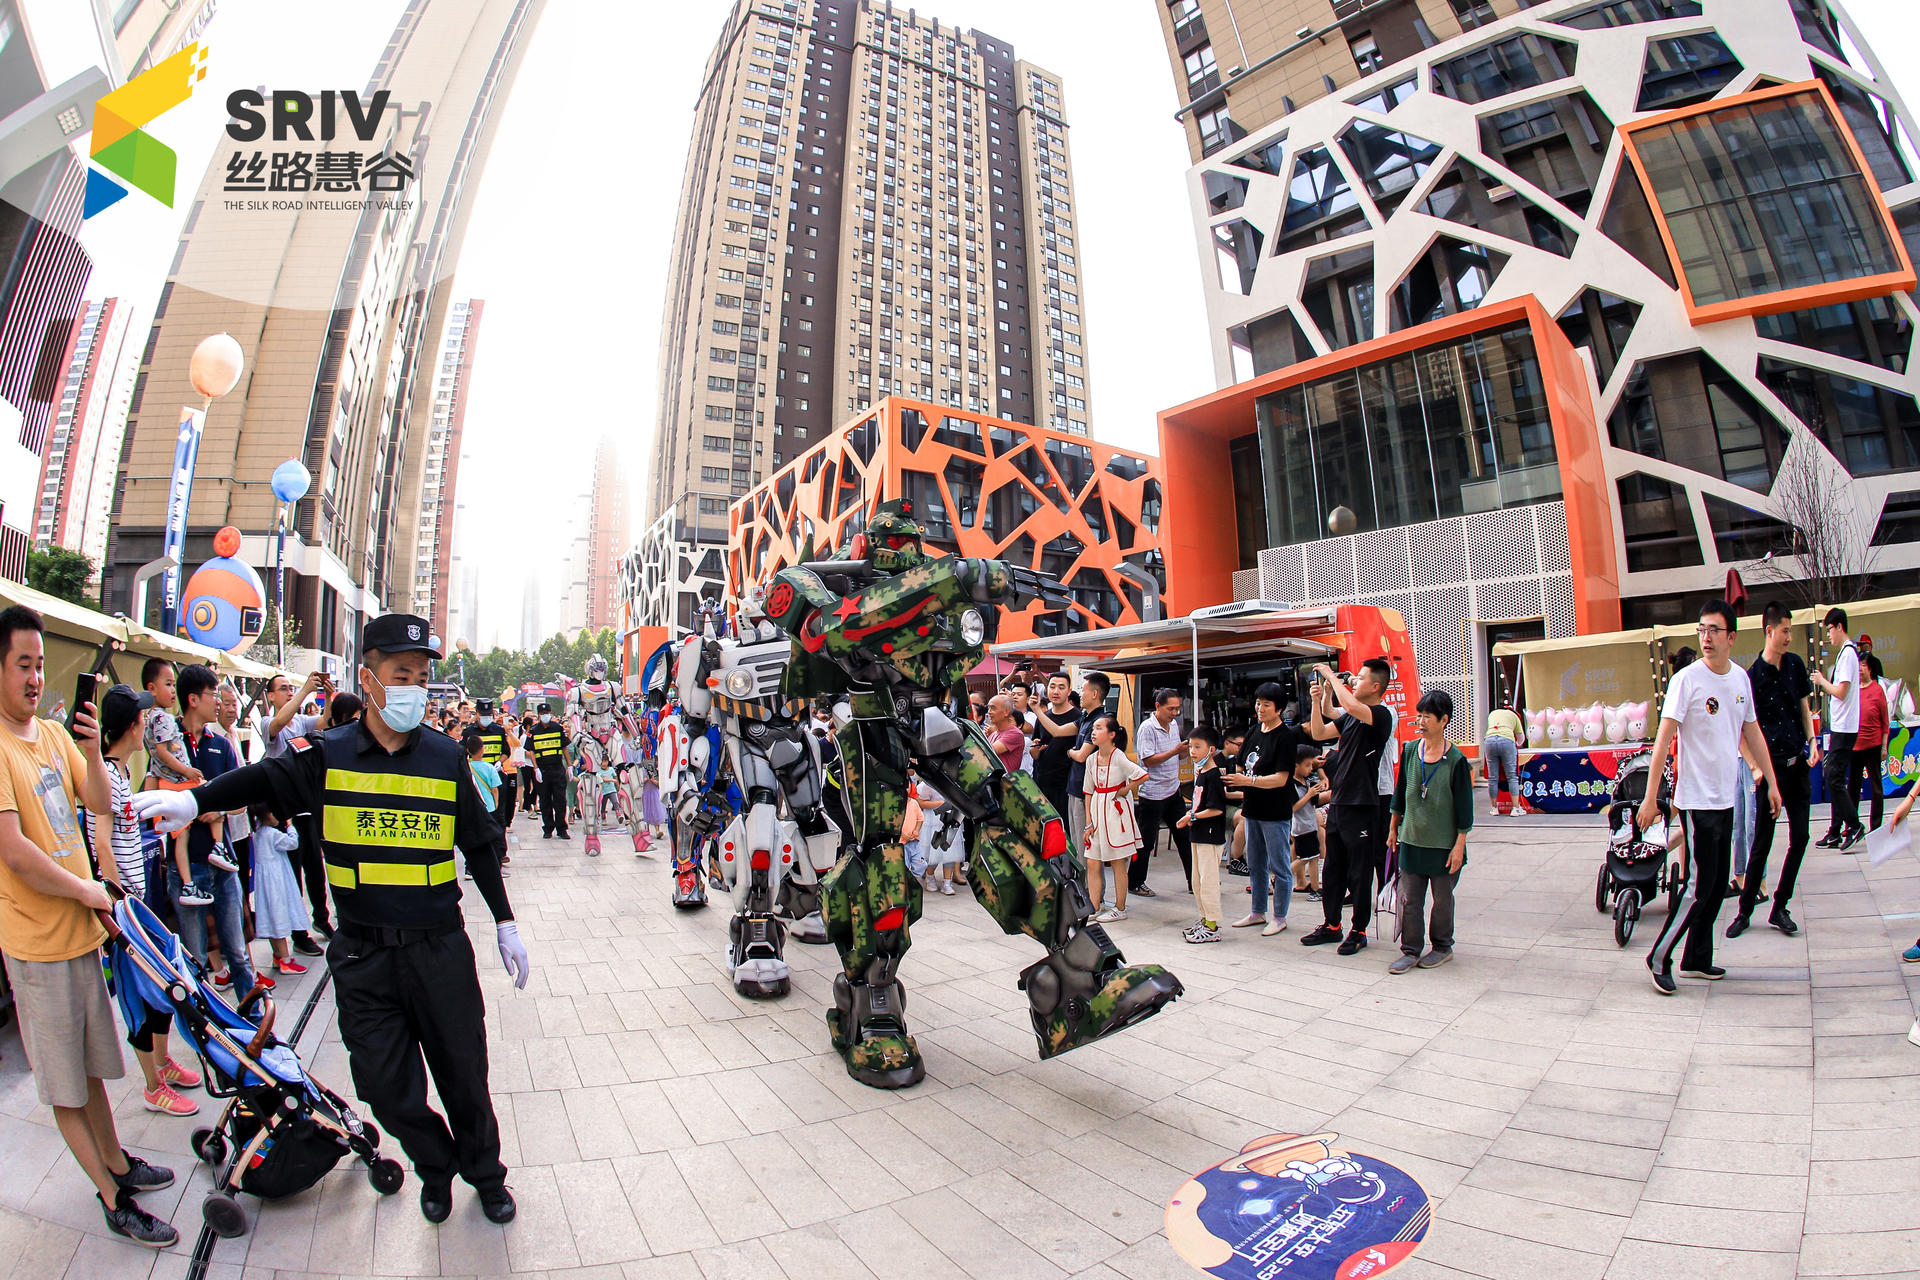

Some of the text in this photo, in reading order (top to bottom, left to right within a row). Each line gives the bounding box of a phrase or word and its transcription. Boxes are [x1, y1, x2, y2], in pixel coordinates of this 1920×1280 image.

[356, 811, 441, 832] 泰安安保
[357, 829, 440, 840] TAI AN AN BAO
